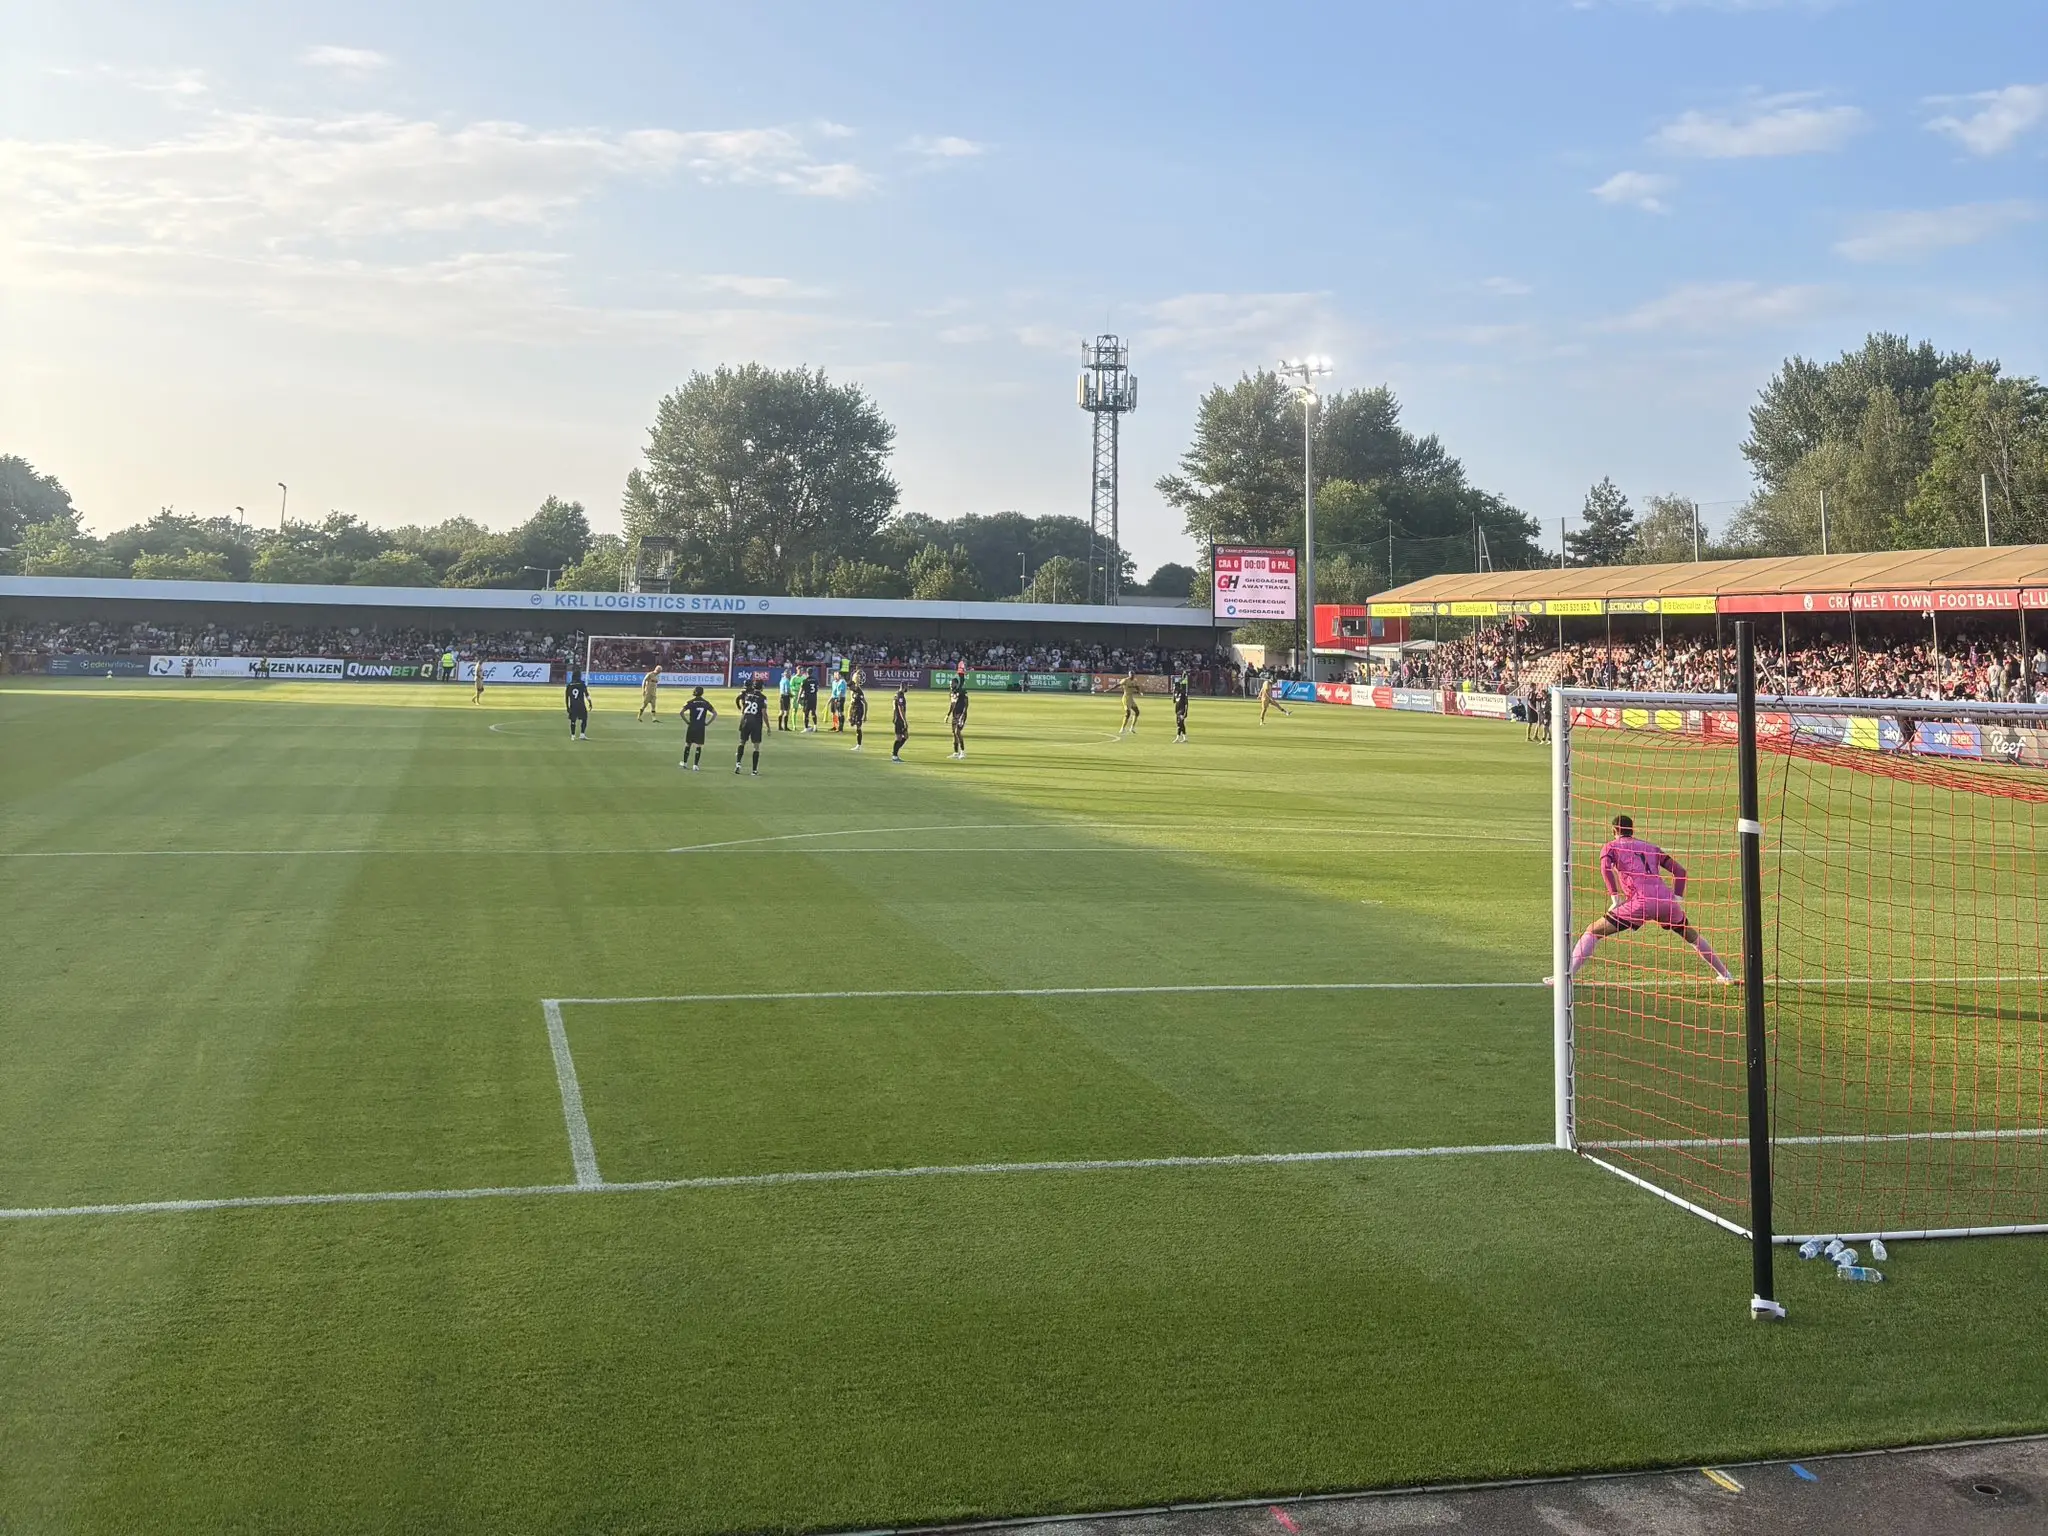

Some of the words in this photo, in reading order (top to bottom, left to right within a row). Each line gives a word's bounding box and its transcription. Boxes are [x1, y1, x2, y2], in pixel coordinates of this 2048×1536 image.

[1219, 560, 1231, 568] CRA
[1234, 560, 1239, 568] 0
[1244, 560, 1266, 569] 00:00
[1271, 561, 1276, 569] 0
[1278, 561, 1290, 570] PAL
[1217, 575, 1240, 589] GH
[555, 594, 588, 607] KRL
[594, 595, 686, 610] LOGISTICS
[690, 597, 746, 611] STAND
[1828, 595, 1885, 608] CRAWLEY
[1892, 595, 1932, 608] TOWN
[1939, 592, 2012, 607] FOOTBALL
[297, 663, 342, 674] KAIZEN
[347, 663, 419, 677] QUINNBET
[873, 670, 922, 678] BEAUFORT
[595, 674, 642, 682] LOGISTICS
[673, 676, 716, 684] LOGISTICS
[738, 671, 752, 681] sky
[754, 671, 769, 680] bet
[809, 683, 816, 693] 3
[987, 679, 1006, 687] Health
[573, 688, 579, 699] 9
[696, 707, 705, 720] 7
[743, 701, 758, 715] 28
[1934, 730, 1951, 746] sky
[1990, 730, 2027, 758] Reef
[1634, 852, 1652, 874] 1
